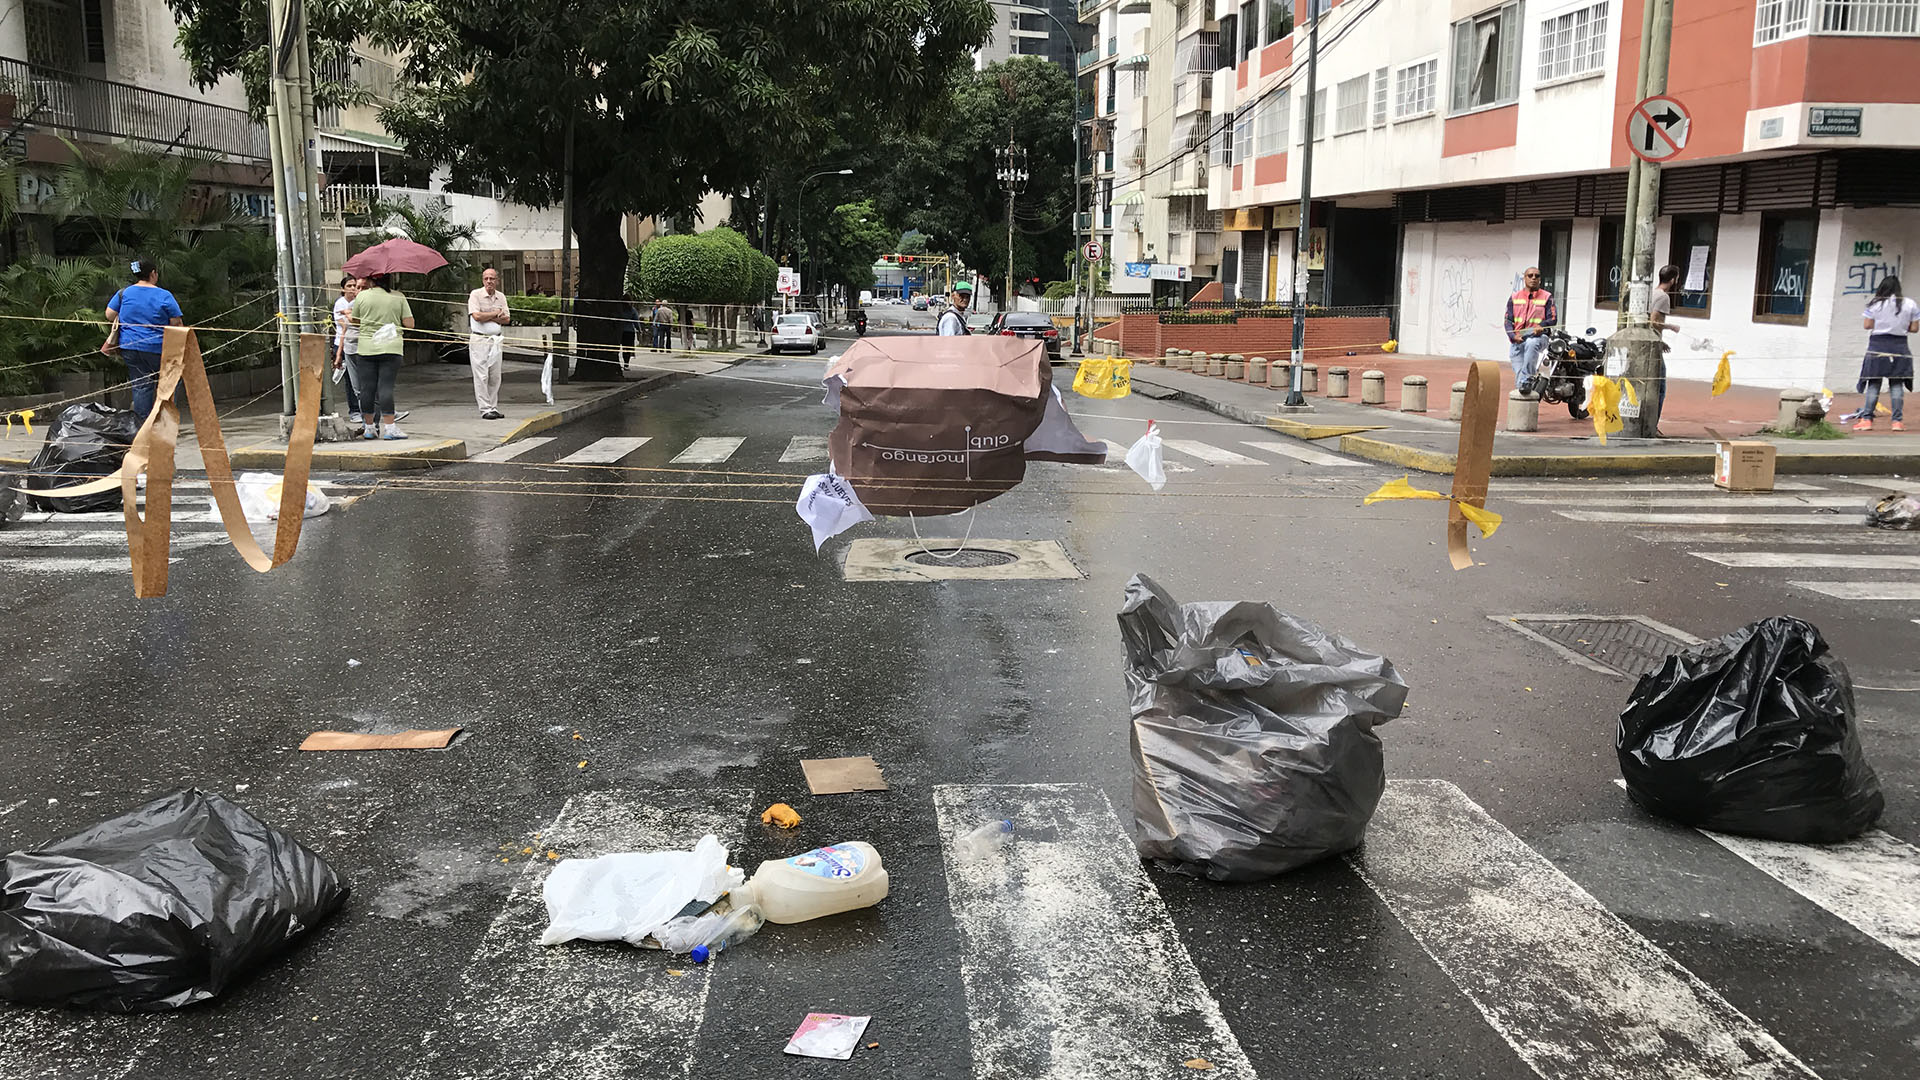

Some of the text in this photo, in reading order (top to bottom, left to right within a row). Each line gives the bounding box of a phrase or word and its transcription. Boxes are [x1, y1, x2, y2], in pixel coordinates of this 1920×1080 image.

[1811, 125, 1858, 133] TRANSVERSAL
[1088, 244, 1098, 259] E
[971, 434, 1010, 449] club
[881, 450, 966, 465] morango
[832, 481, 854, 508] JUEVES
